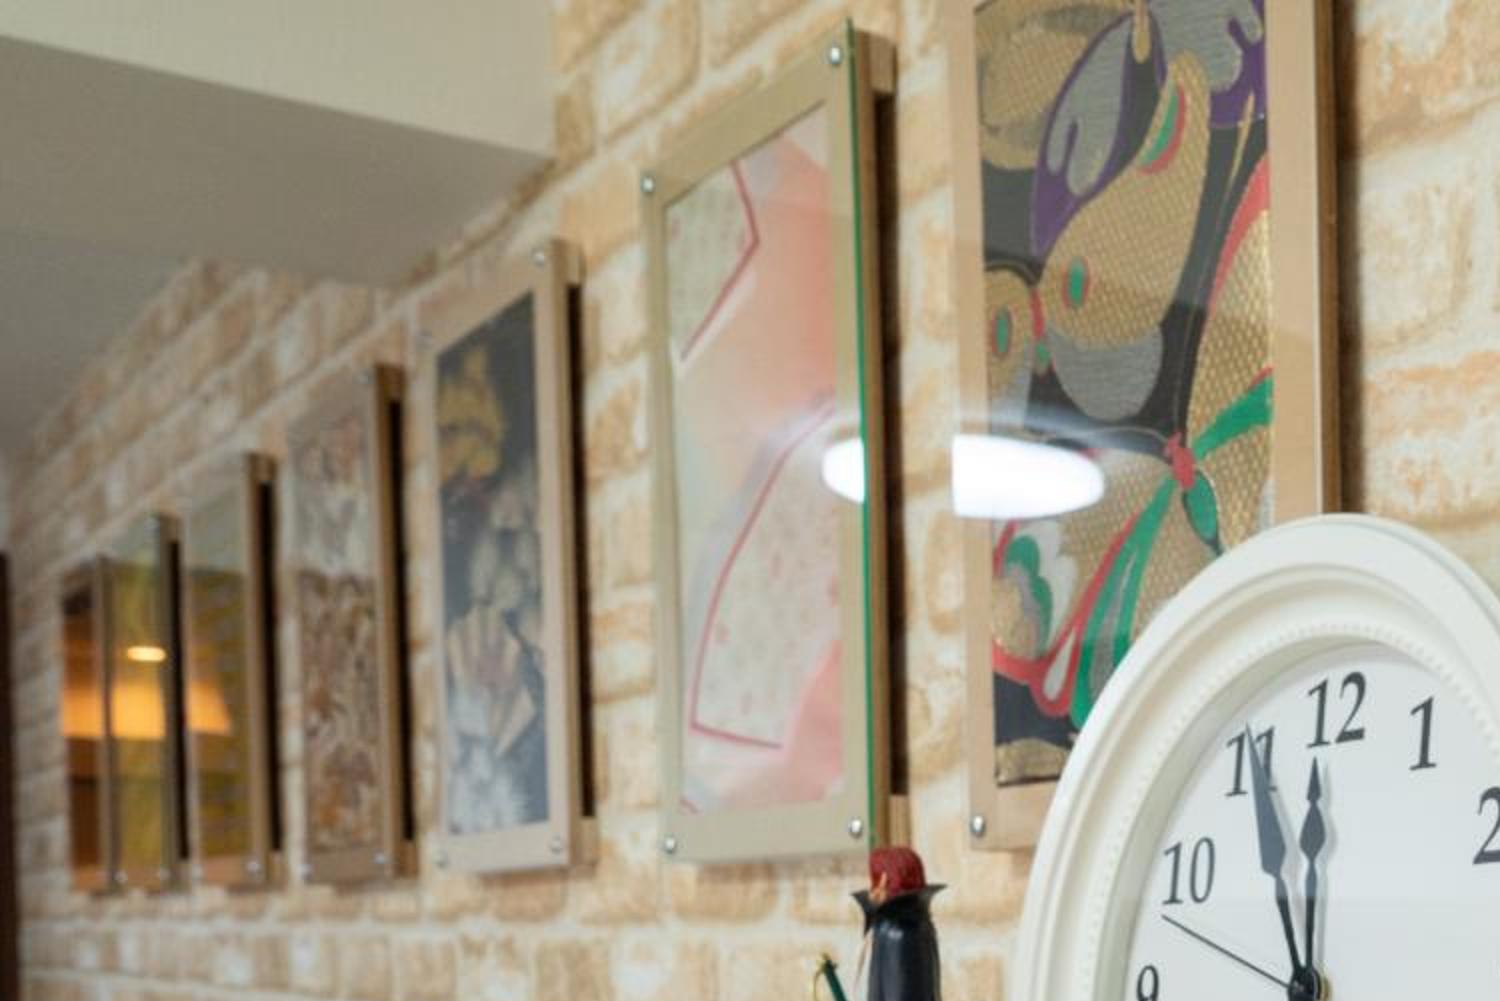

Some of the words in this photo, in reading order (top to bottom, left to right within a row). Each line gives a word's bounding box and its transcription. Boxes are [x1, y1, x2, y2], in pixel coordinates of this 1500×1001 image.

[1305, 670, 1368, 749] 12
[1409, 697, 1438, 771] 1
[1224, 726, 1279, 797] 11
[1162, 837, 1217, 905] 10
